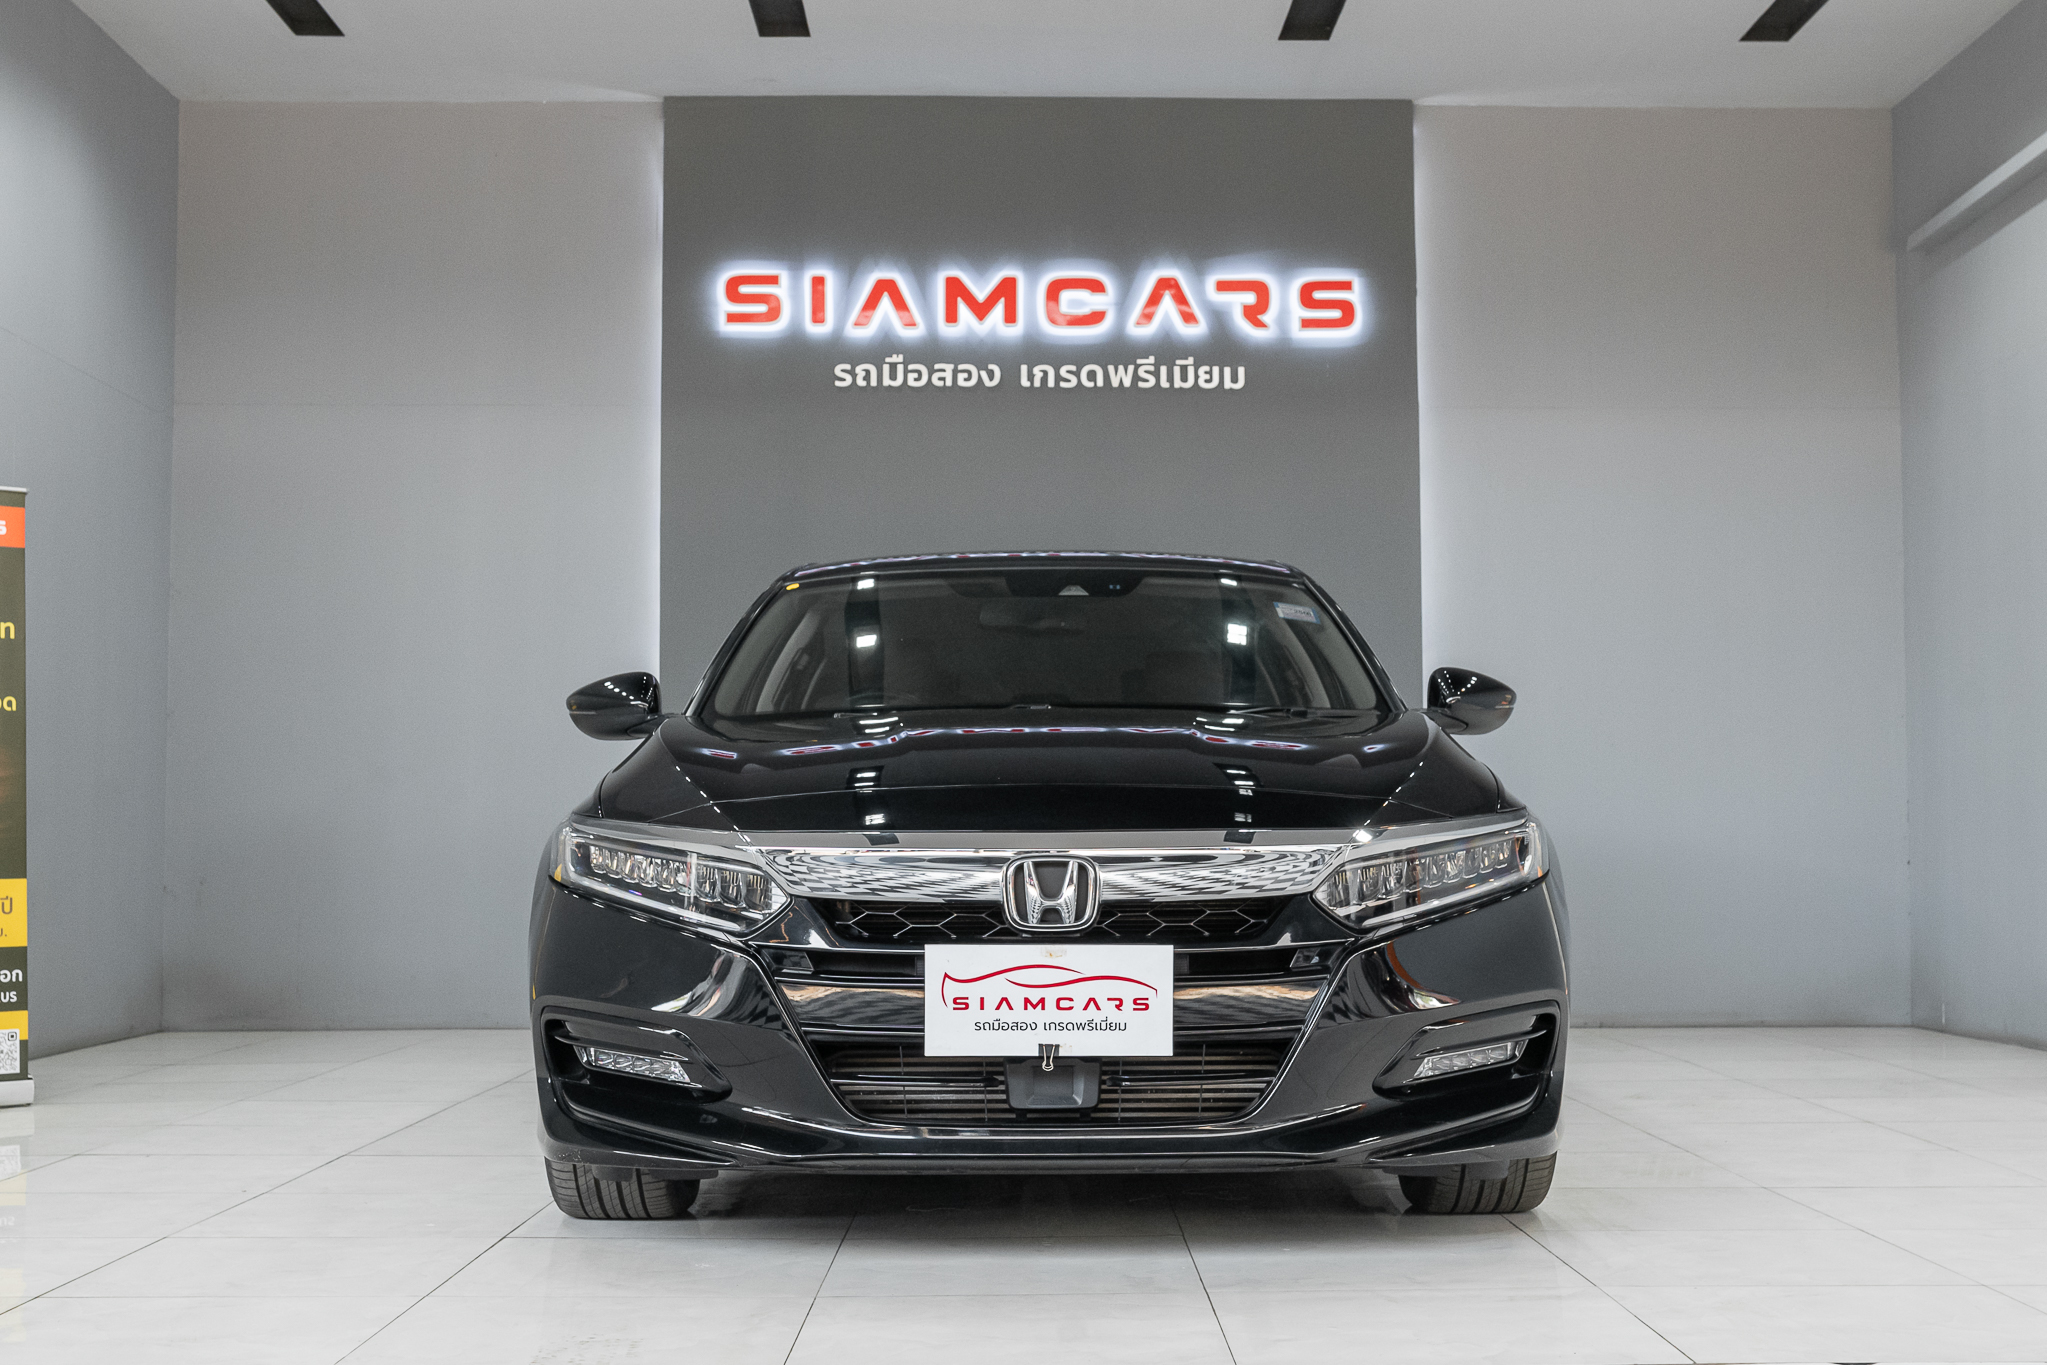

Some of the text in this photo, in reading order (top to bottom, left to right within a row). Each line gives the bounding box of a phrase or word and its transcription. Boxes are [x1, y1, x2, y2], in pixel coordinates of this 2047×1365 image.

[725, 274, 1356, 329] SIAMCARS
[833, 353, 1246, 390] รถมือสอง เกรดพรีเมียม
[952, 996, 1150, 1012] SIAMCARS
[974, 1016, 1127, 1032] รถมือสอง เกรดพรีเมี่ยม
